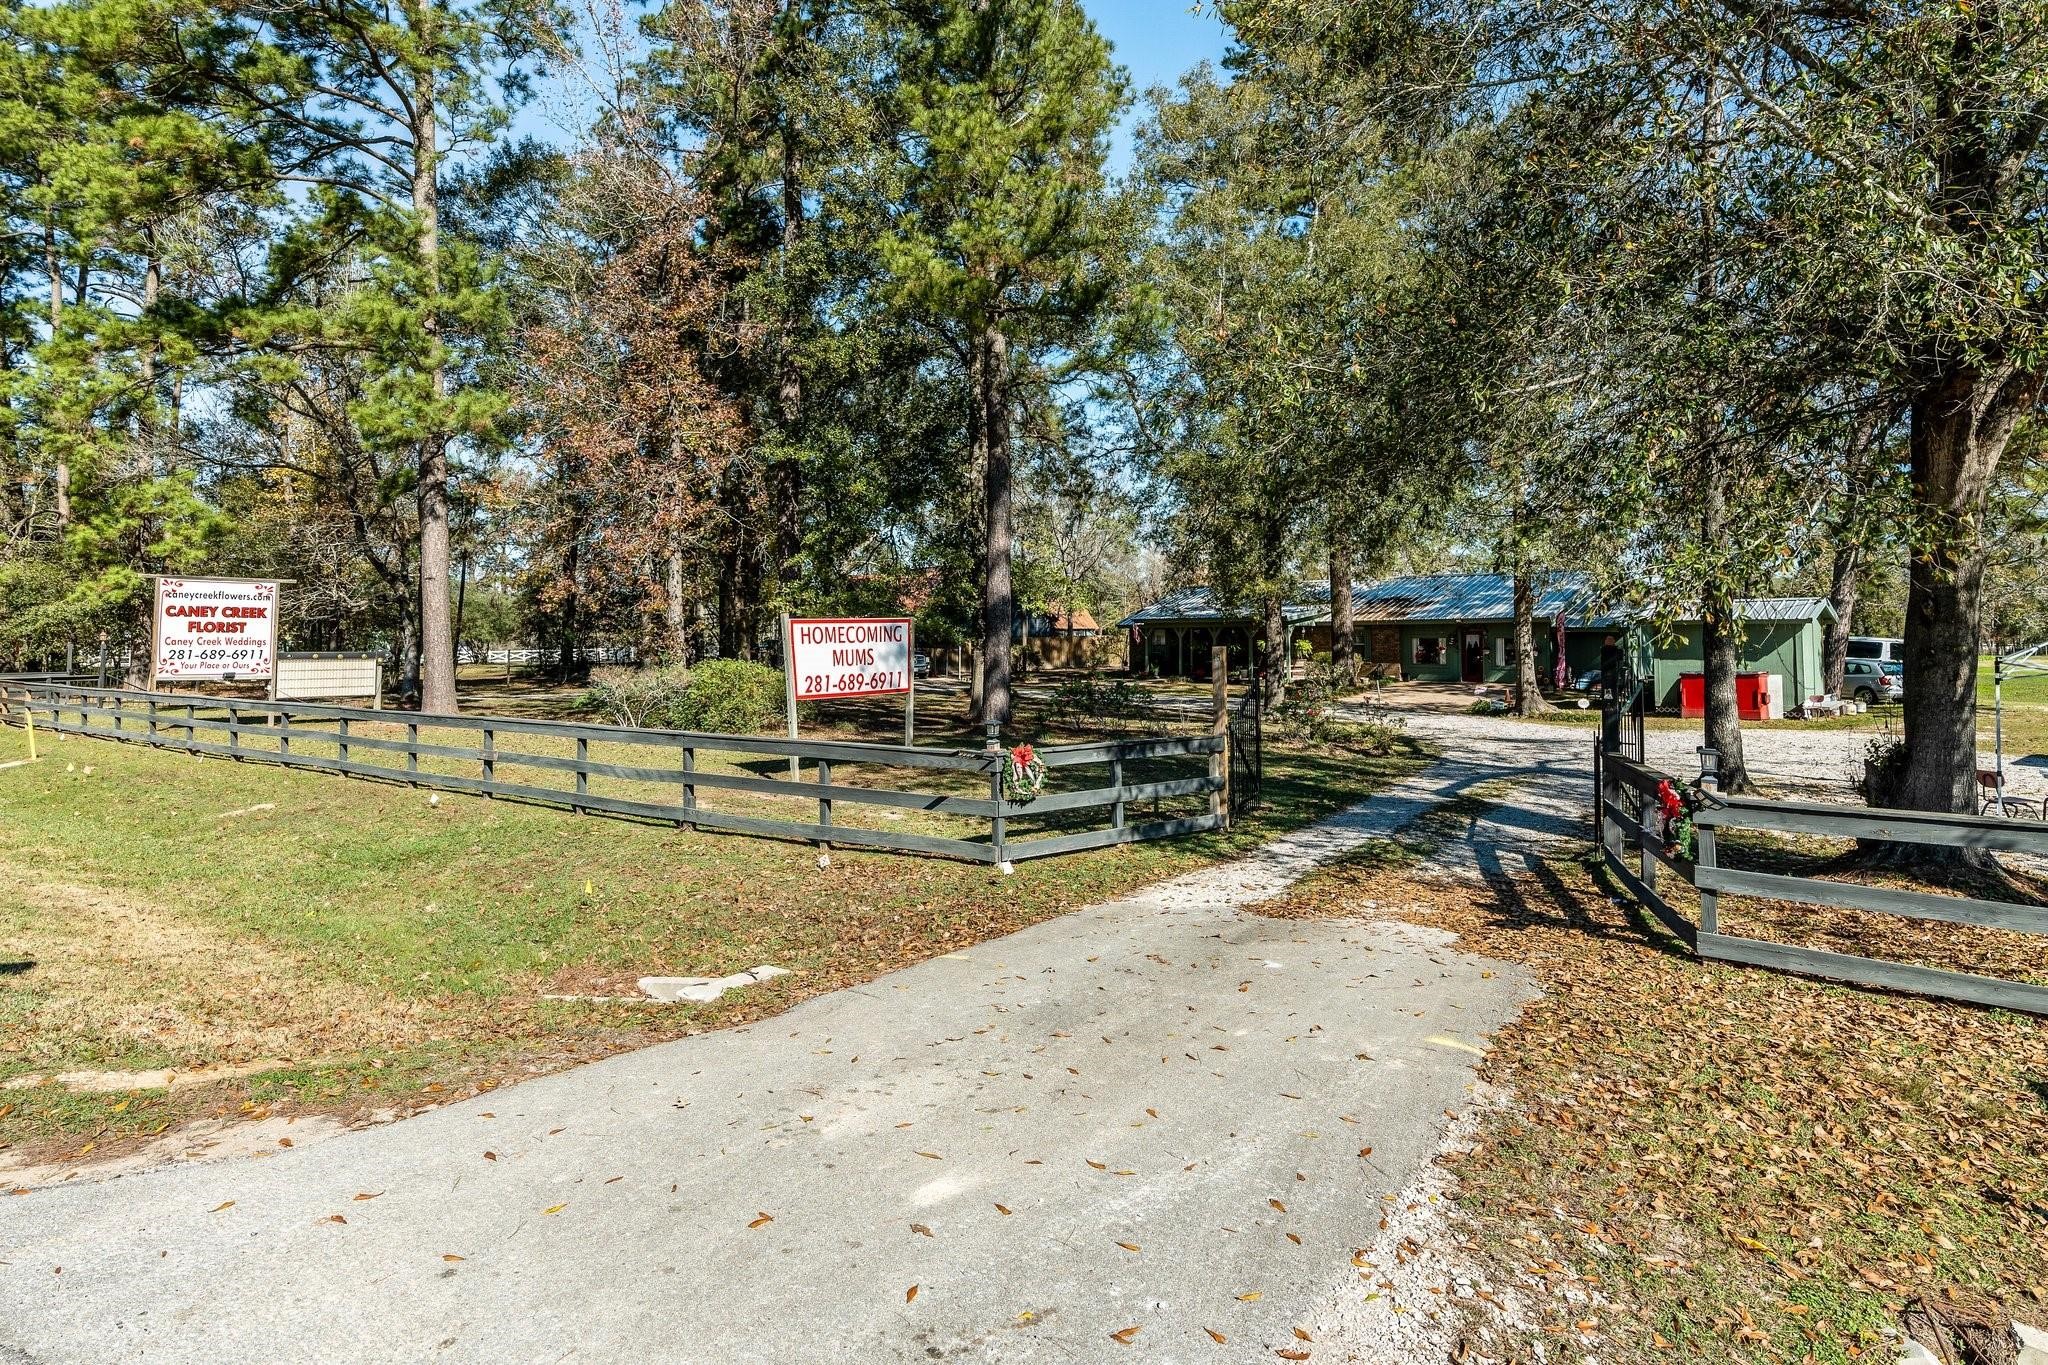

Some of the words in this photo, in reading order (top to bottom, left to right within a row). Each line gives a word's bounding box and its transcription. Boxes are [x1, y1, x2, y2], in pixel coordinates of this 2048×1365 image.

[168, 590, 271, 601] caneycreekflowers.com
[165, 605, 219, 618] CANEY
[221, 606, 268, 619] CREEK
[187, 621, 247, 634] FLORIST
[800, 625, 903, 645] HOMECOMING
[164, 636, 194, 647] Caney
[196, 636, 222, 646] Creek
[224, 637, 267, 648] Weddings
[168, 649, 264, 660] 281-689-6911
[832, 648, 875, 667] MUMS
[180, 661, 197, 669] Your
[199, 661, 220, 669] Place
[232, 661, 250, 669] Ours
[804, 671, 903, 694] 281-689-6911
